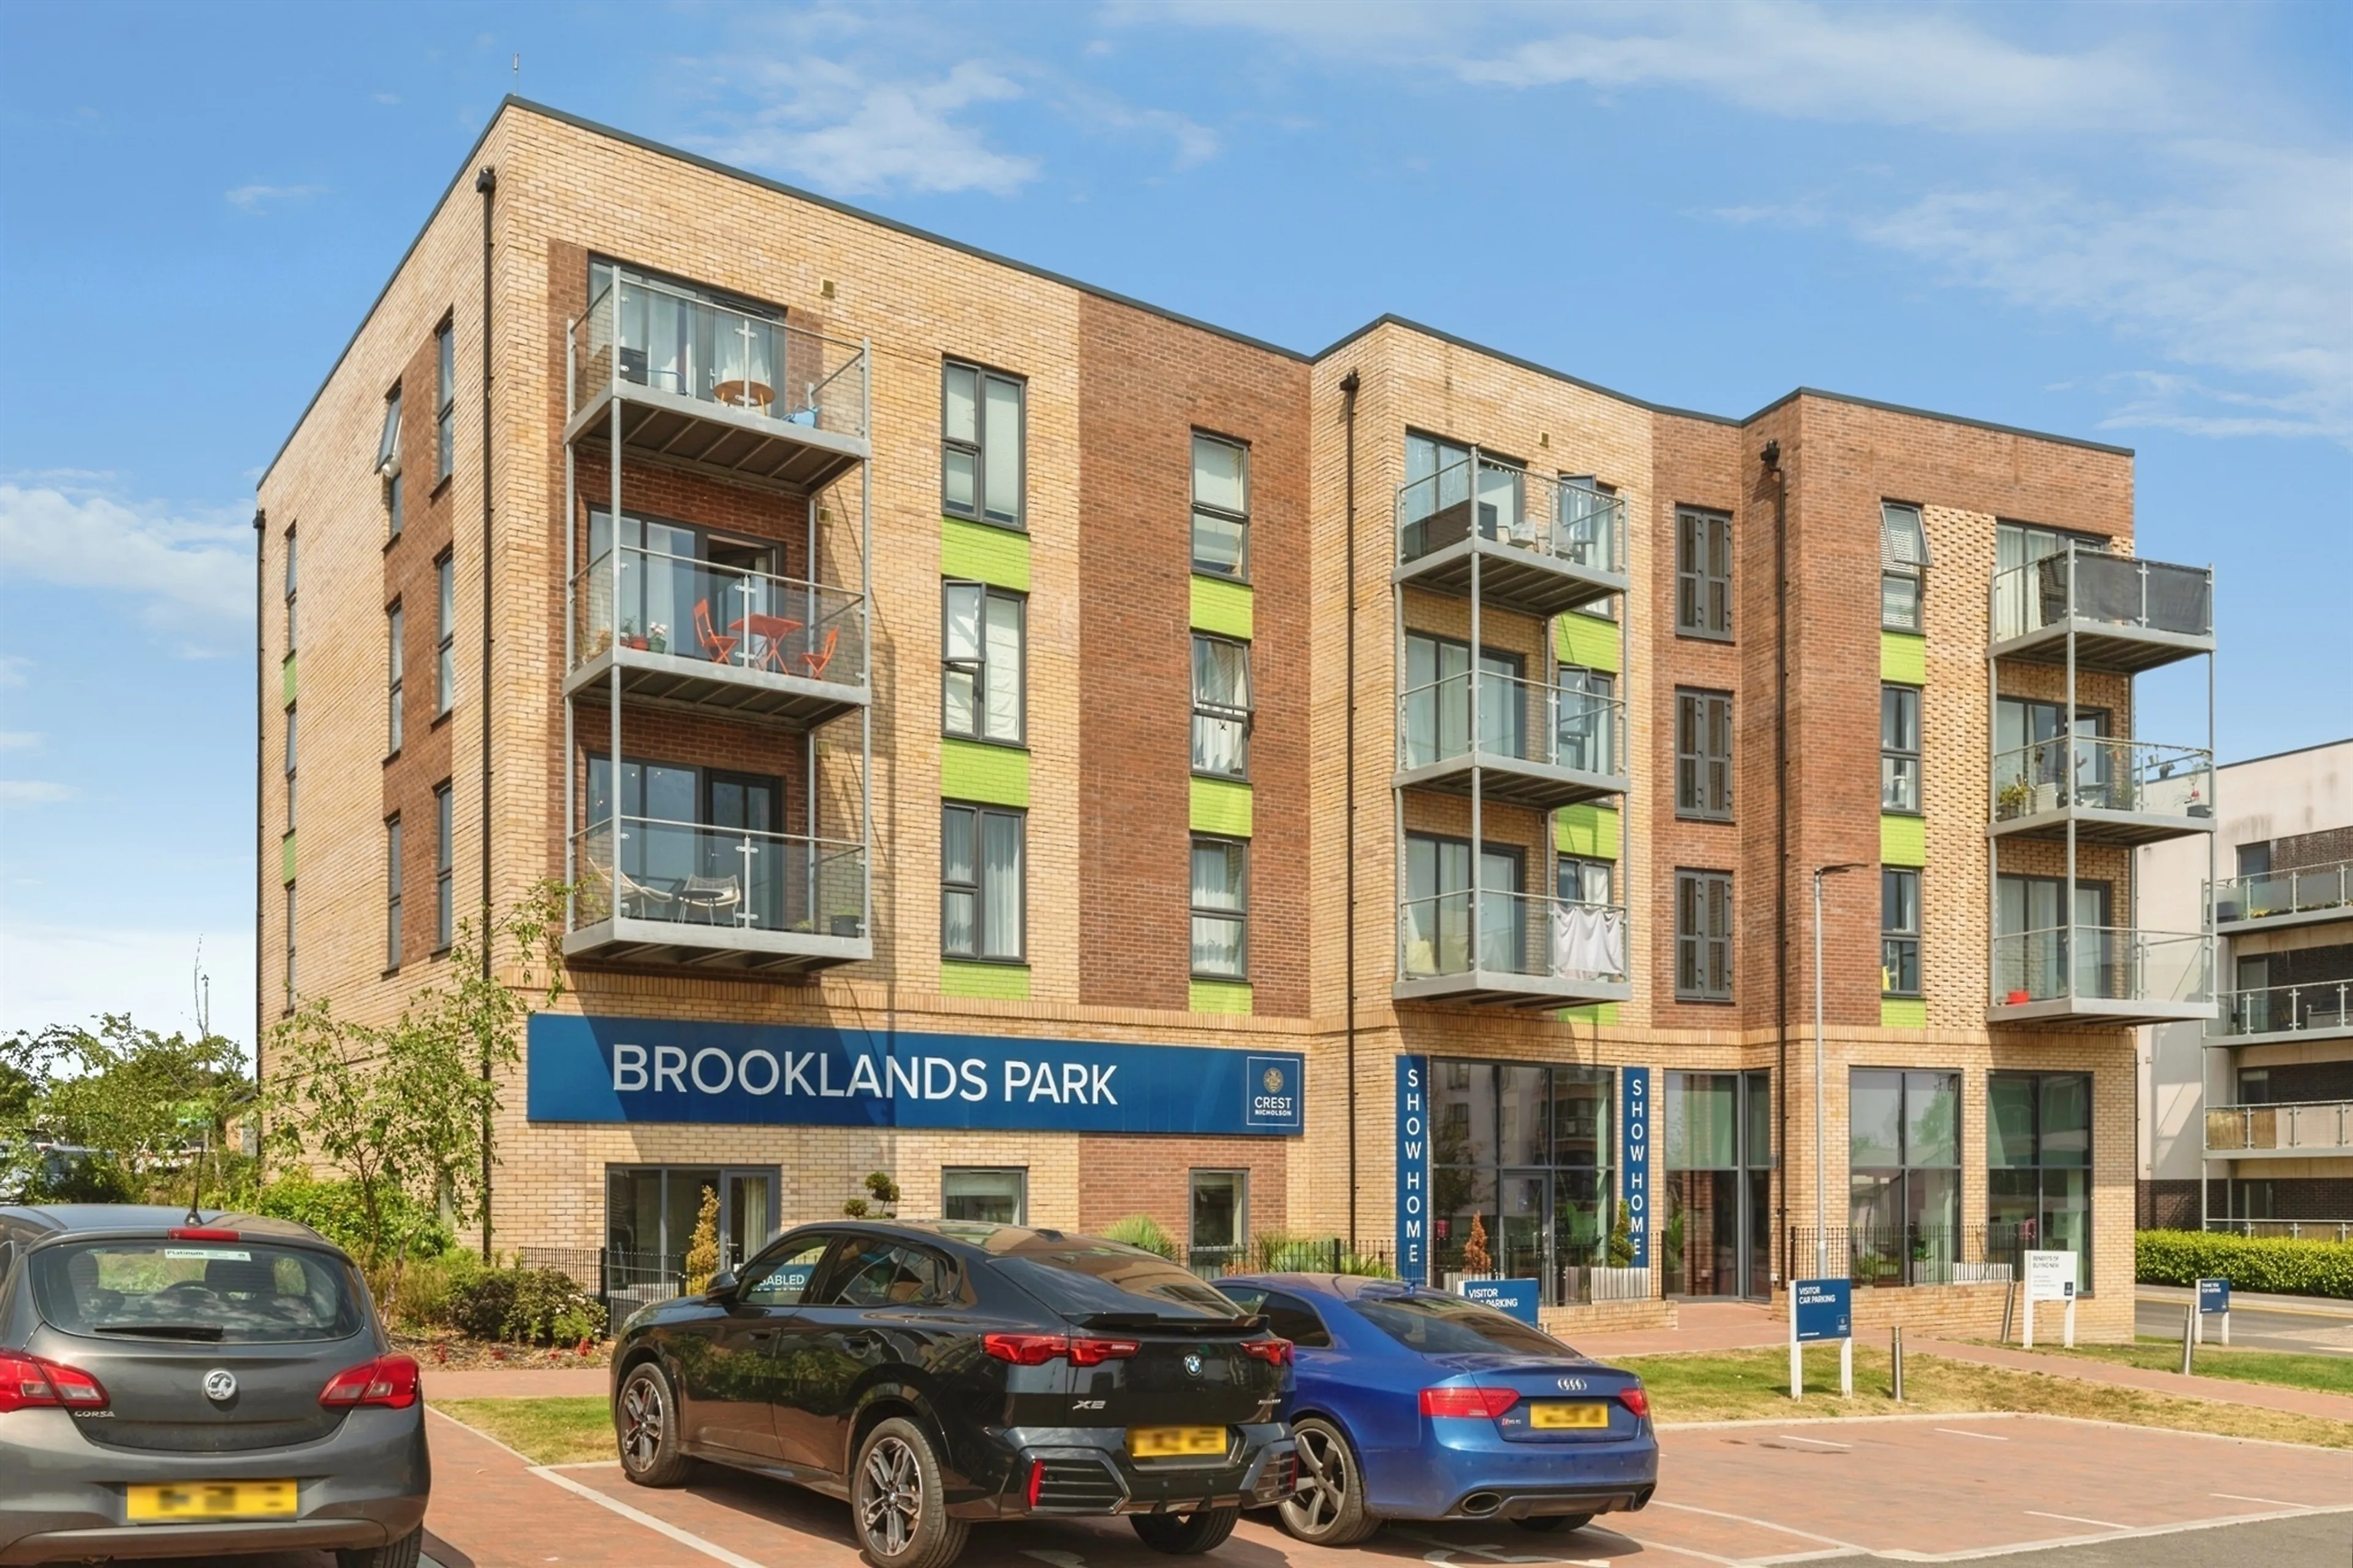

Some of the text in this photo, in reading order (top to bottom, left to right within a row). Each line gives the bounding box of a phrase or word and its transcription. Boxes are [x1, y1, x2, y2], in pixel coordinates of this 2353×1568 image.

[613, 1044, 1118, 1105] BROOKLANDS PARK
[1254, 1096, 1292, 1108] CREST
[1405, 1069, 1422, 1262] SHOW HOME
[1630, 1079, 1645, 1255] SHOW HOME
[1468, 1289, 1498, 1298] VISITOR
[1798, 1294, 1836, 1305] CAR PARKING
[1072, 1400, 1106, 1410] X2
